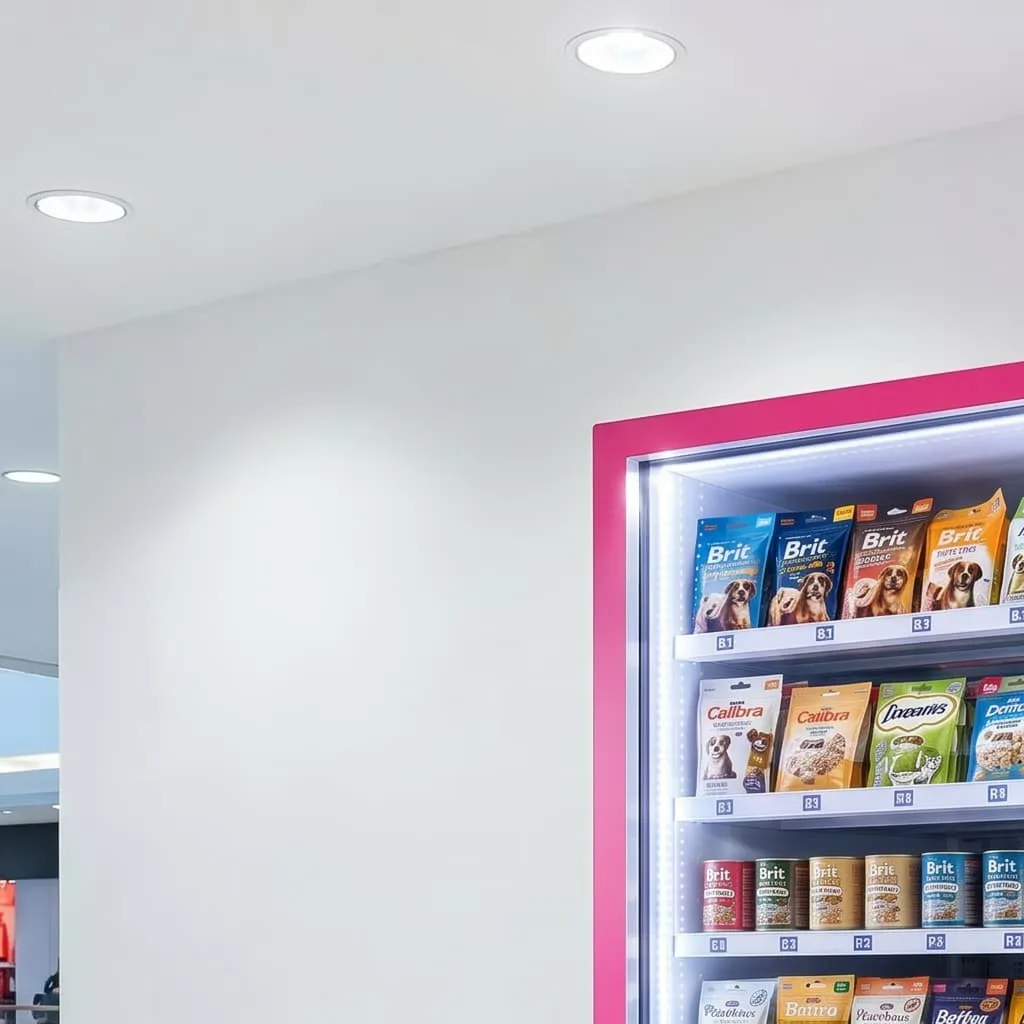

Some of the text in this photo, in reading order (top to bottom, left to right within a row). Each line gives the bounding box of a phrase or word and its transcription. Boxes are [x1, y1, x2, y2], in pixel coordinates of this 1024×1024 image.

[861, 529, 908, 551] Brit
[706, 542, 752, 565] Brit
[783, 537, 829, 561] Brit
[759, 866, 786, 881] Brit
[926, 859, 955, 875] Brit
[988, 858, 1017, 873] Brit
[706, 866, 731, 882] Brit
